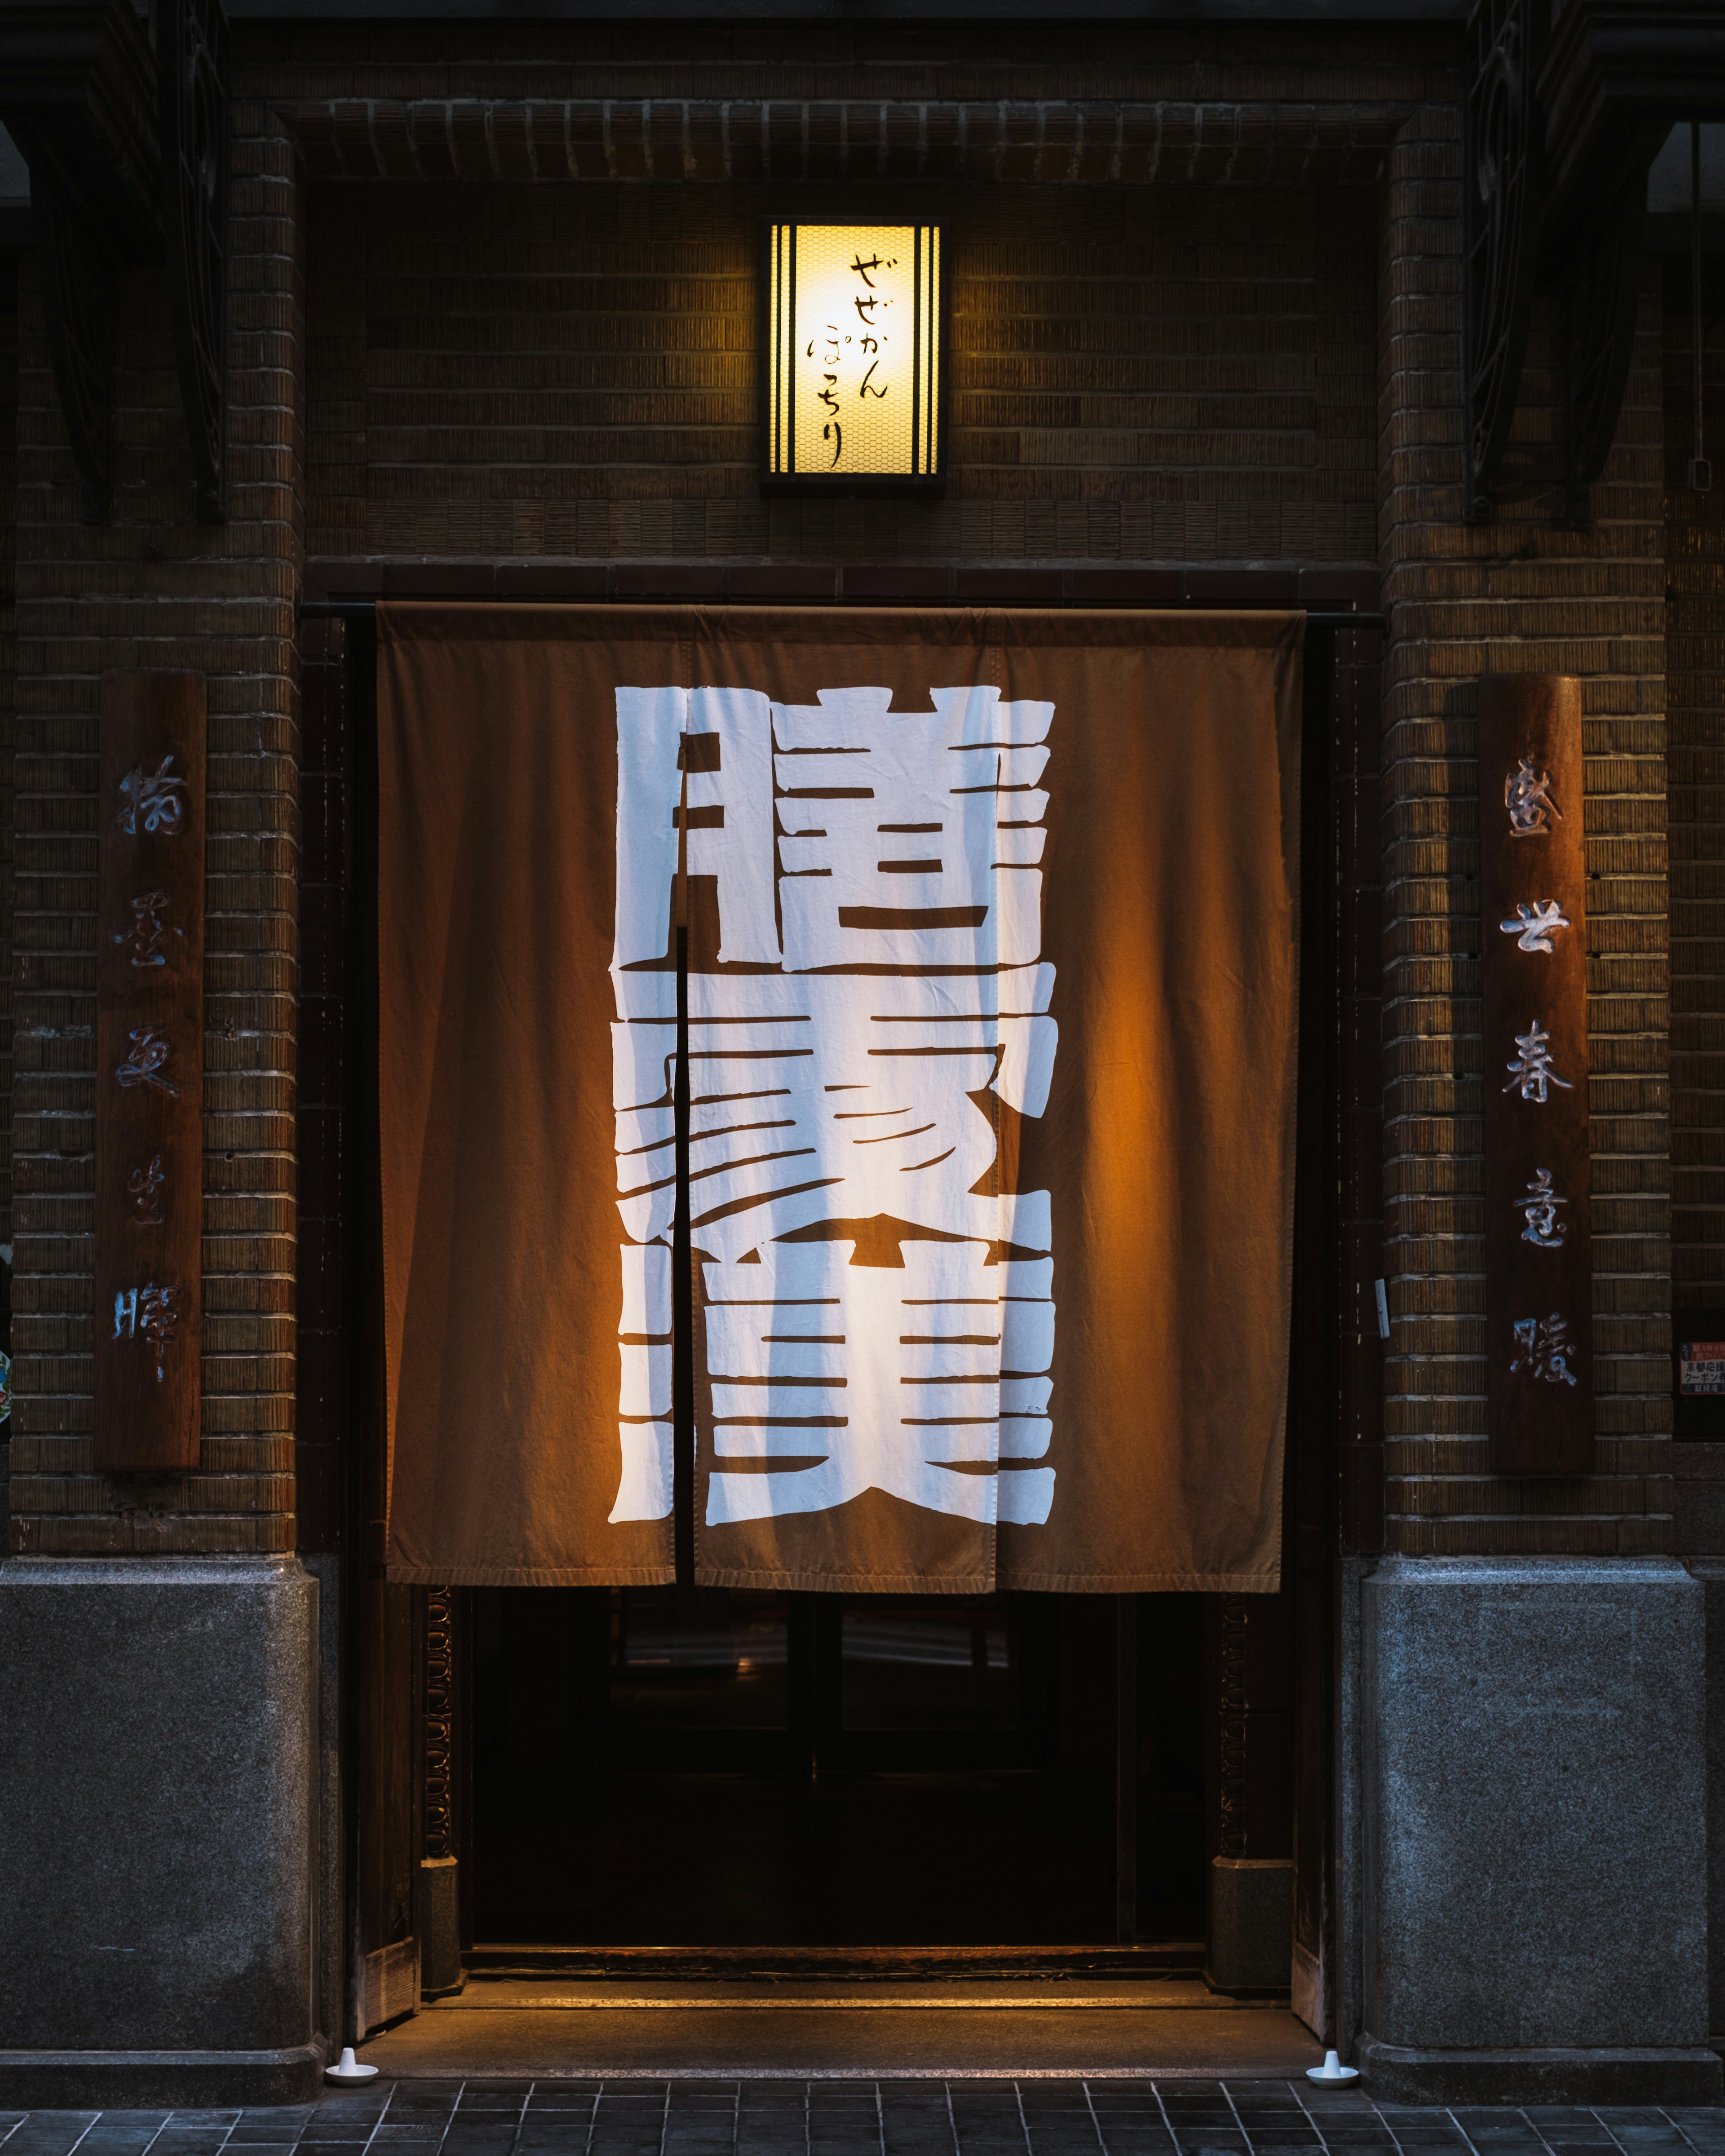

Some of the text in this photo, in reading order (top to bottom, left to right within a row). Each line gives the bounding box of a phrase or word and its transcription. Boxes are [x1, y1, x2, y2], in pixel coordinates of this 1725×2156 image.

[807, 325, 852, 468] ぽっちり
[850, 253, 898, 398] ぜぜかん
